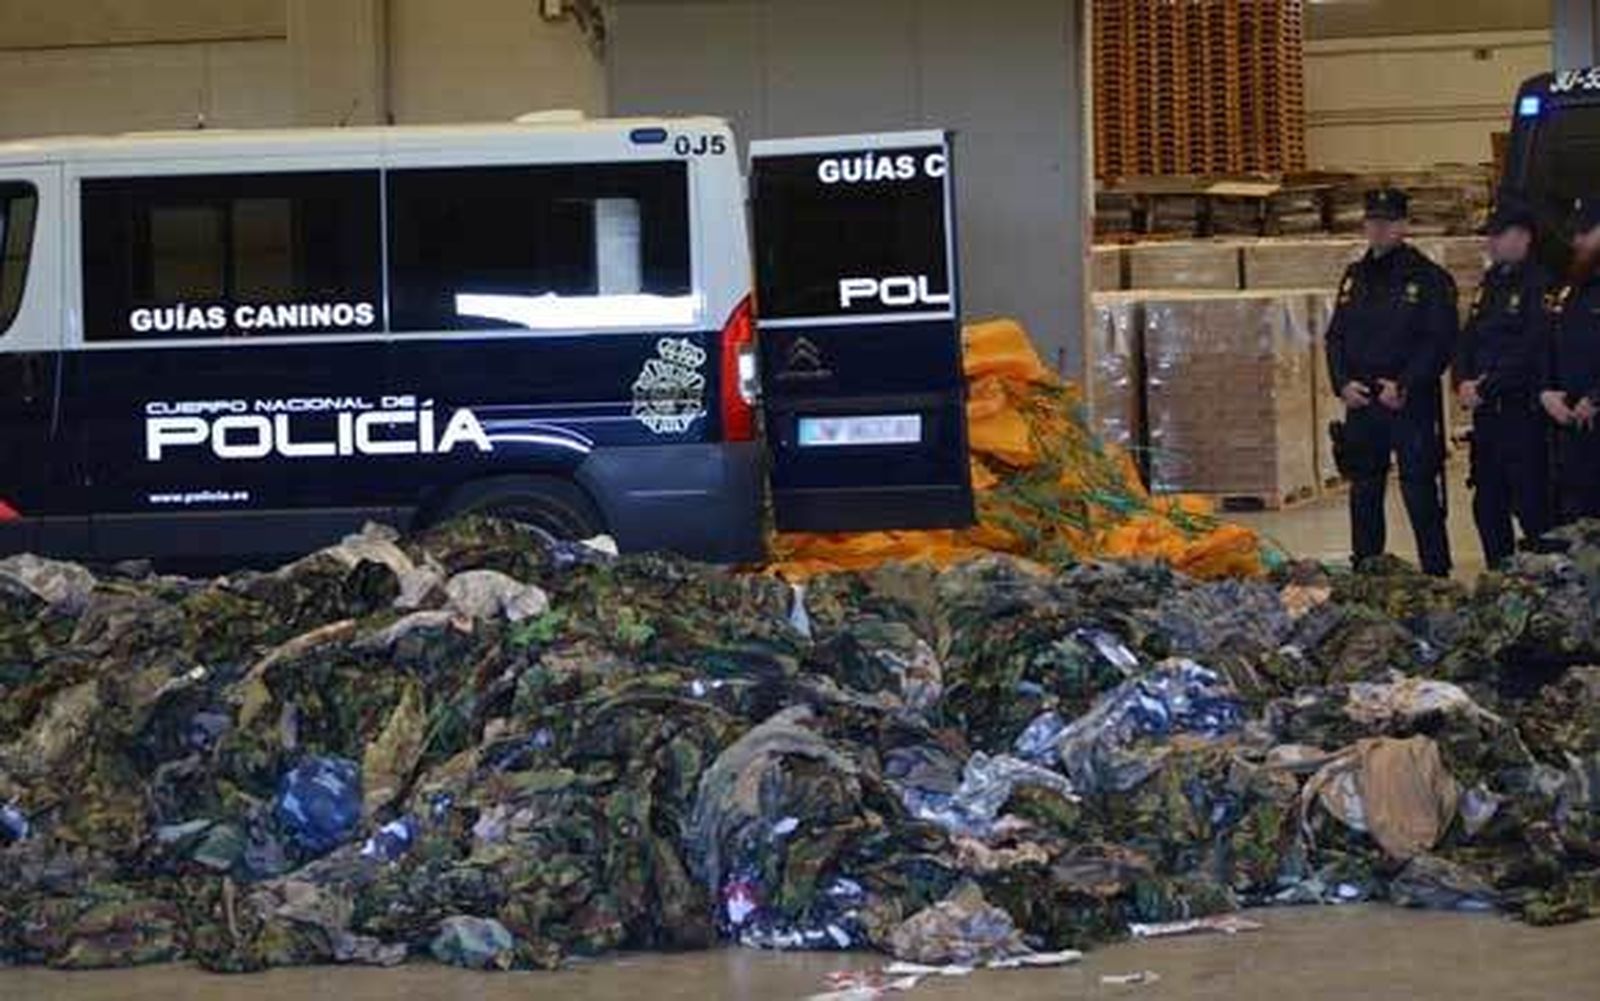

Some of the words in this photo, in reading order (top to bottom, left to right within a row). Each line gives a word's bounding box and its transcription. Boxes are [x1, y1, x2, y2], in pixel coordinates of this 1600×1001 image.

[818, 152, 916, 183] GUÍAS
[839, 275, 950, 309] POL
[130, 303, 227, 332] GUÍAS
[234, 302, 375, 328] CANINOS
[146, 401, 247, 415] CUERPO
[255, 398, 374, 412] NACIONAL
[381, 395, 416, 409] DE
[146, 399, 493, 461] POLICÍA
